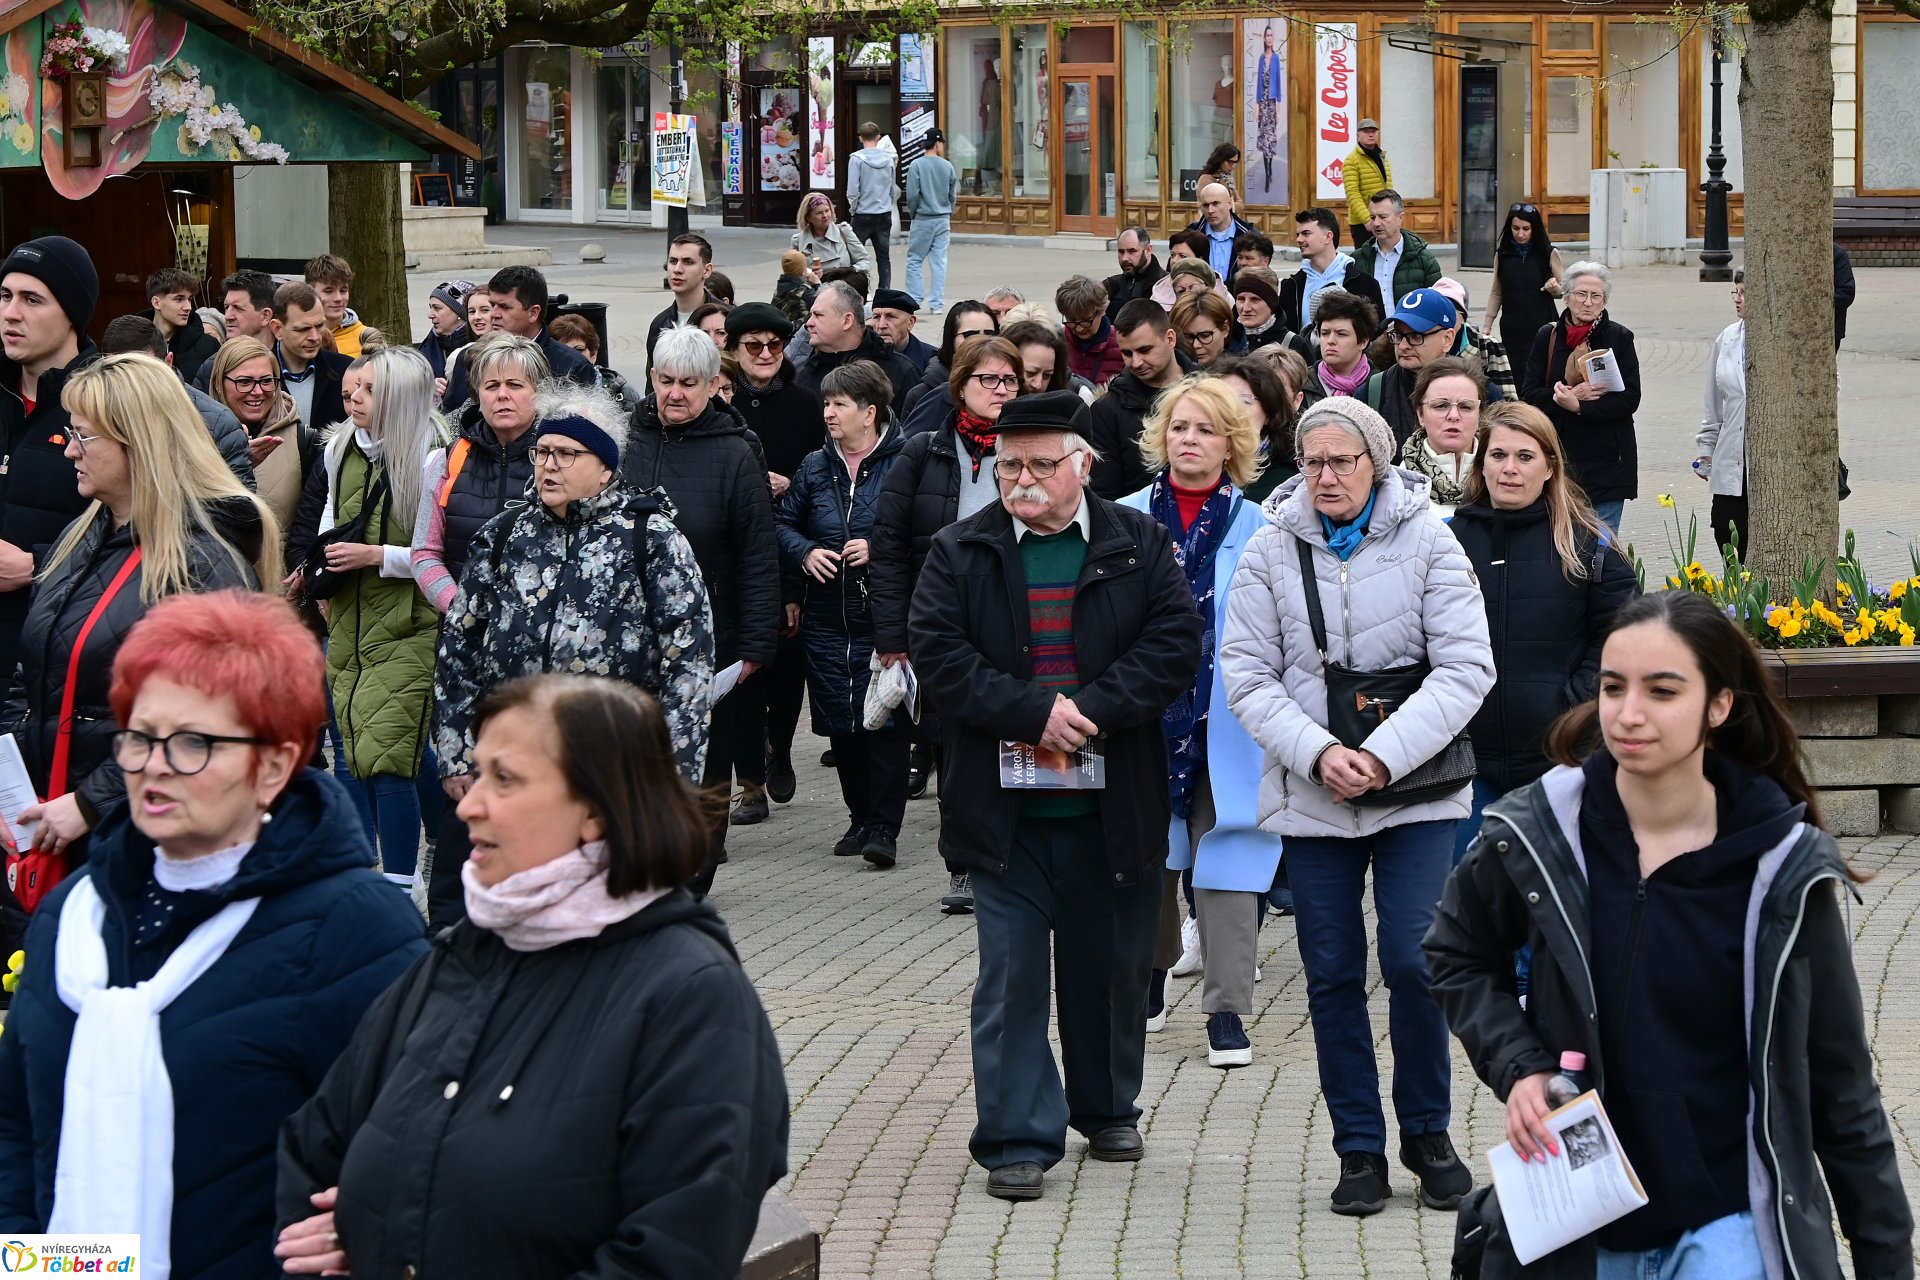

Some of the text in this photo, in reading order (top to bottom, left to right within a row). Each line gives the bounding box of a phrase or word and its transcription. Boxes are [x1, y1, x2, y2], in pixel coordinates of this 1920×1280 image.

[1246, 33, 1255, 123] BARCLAY
[1320, 38, 1355, 143] Lee Cooper
[656, 132, 687, 147] EMBERT
[1183, 179, 1197, 191] CO
[1011, 746, 1023, 785] VÁROSI
[1026, 744, 1036, 785] KERESZ
